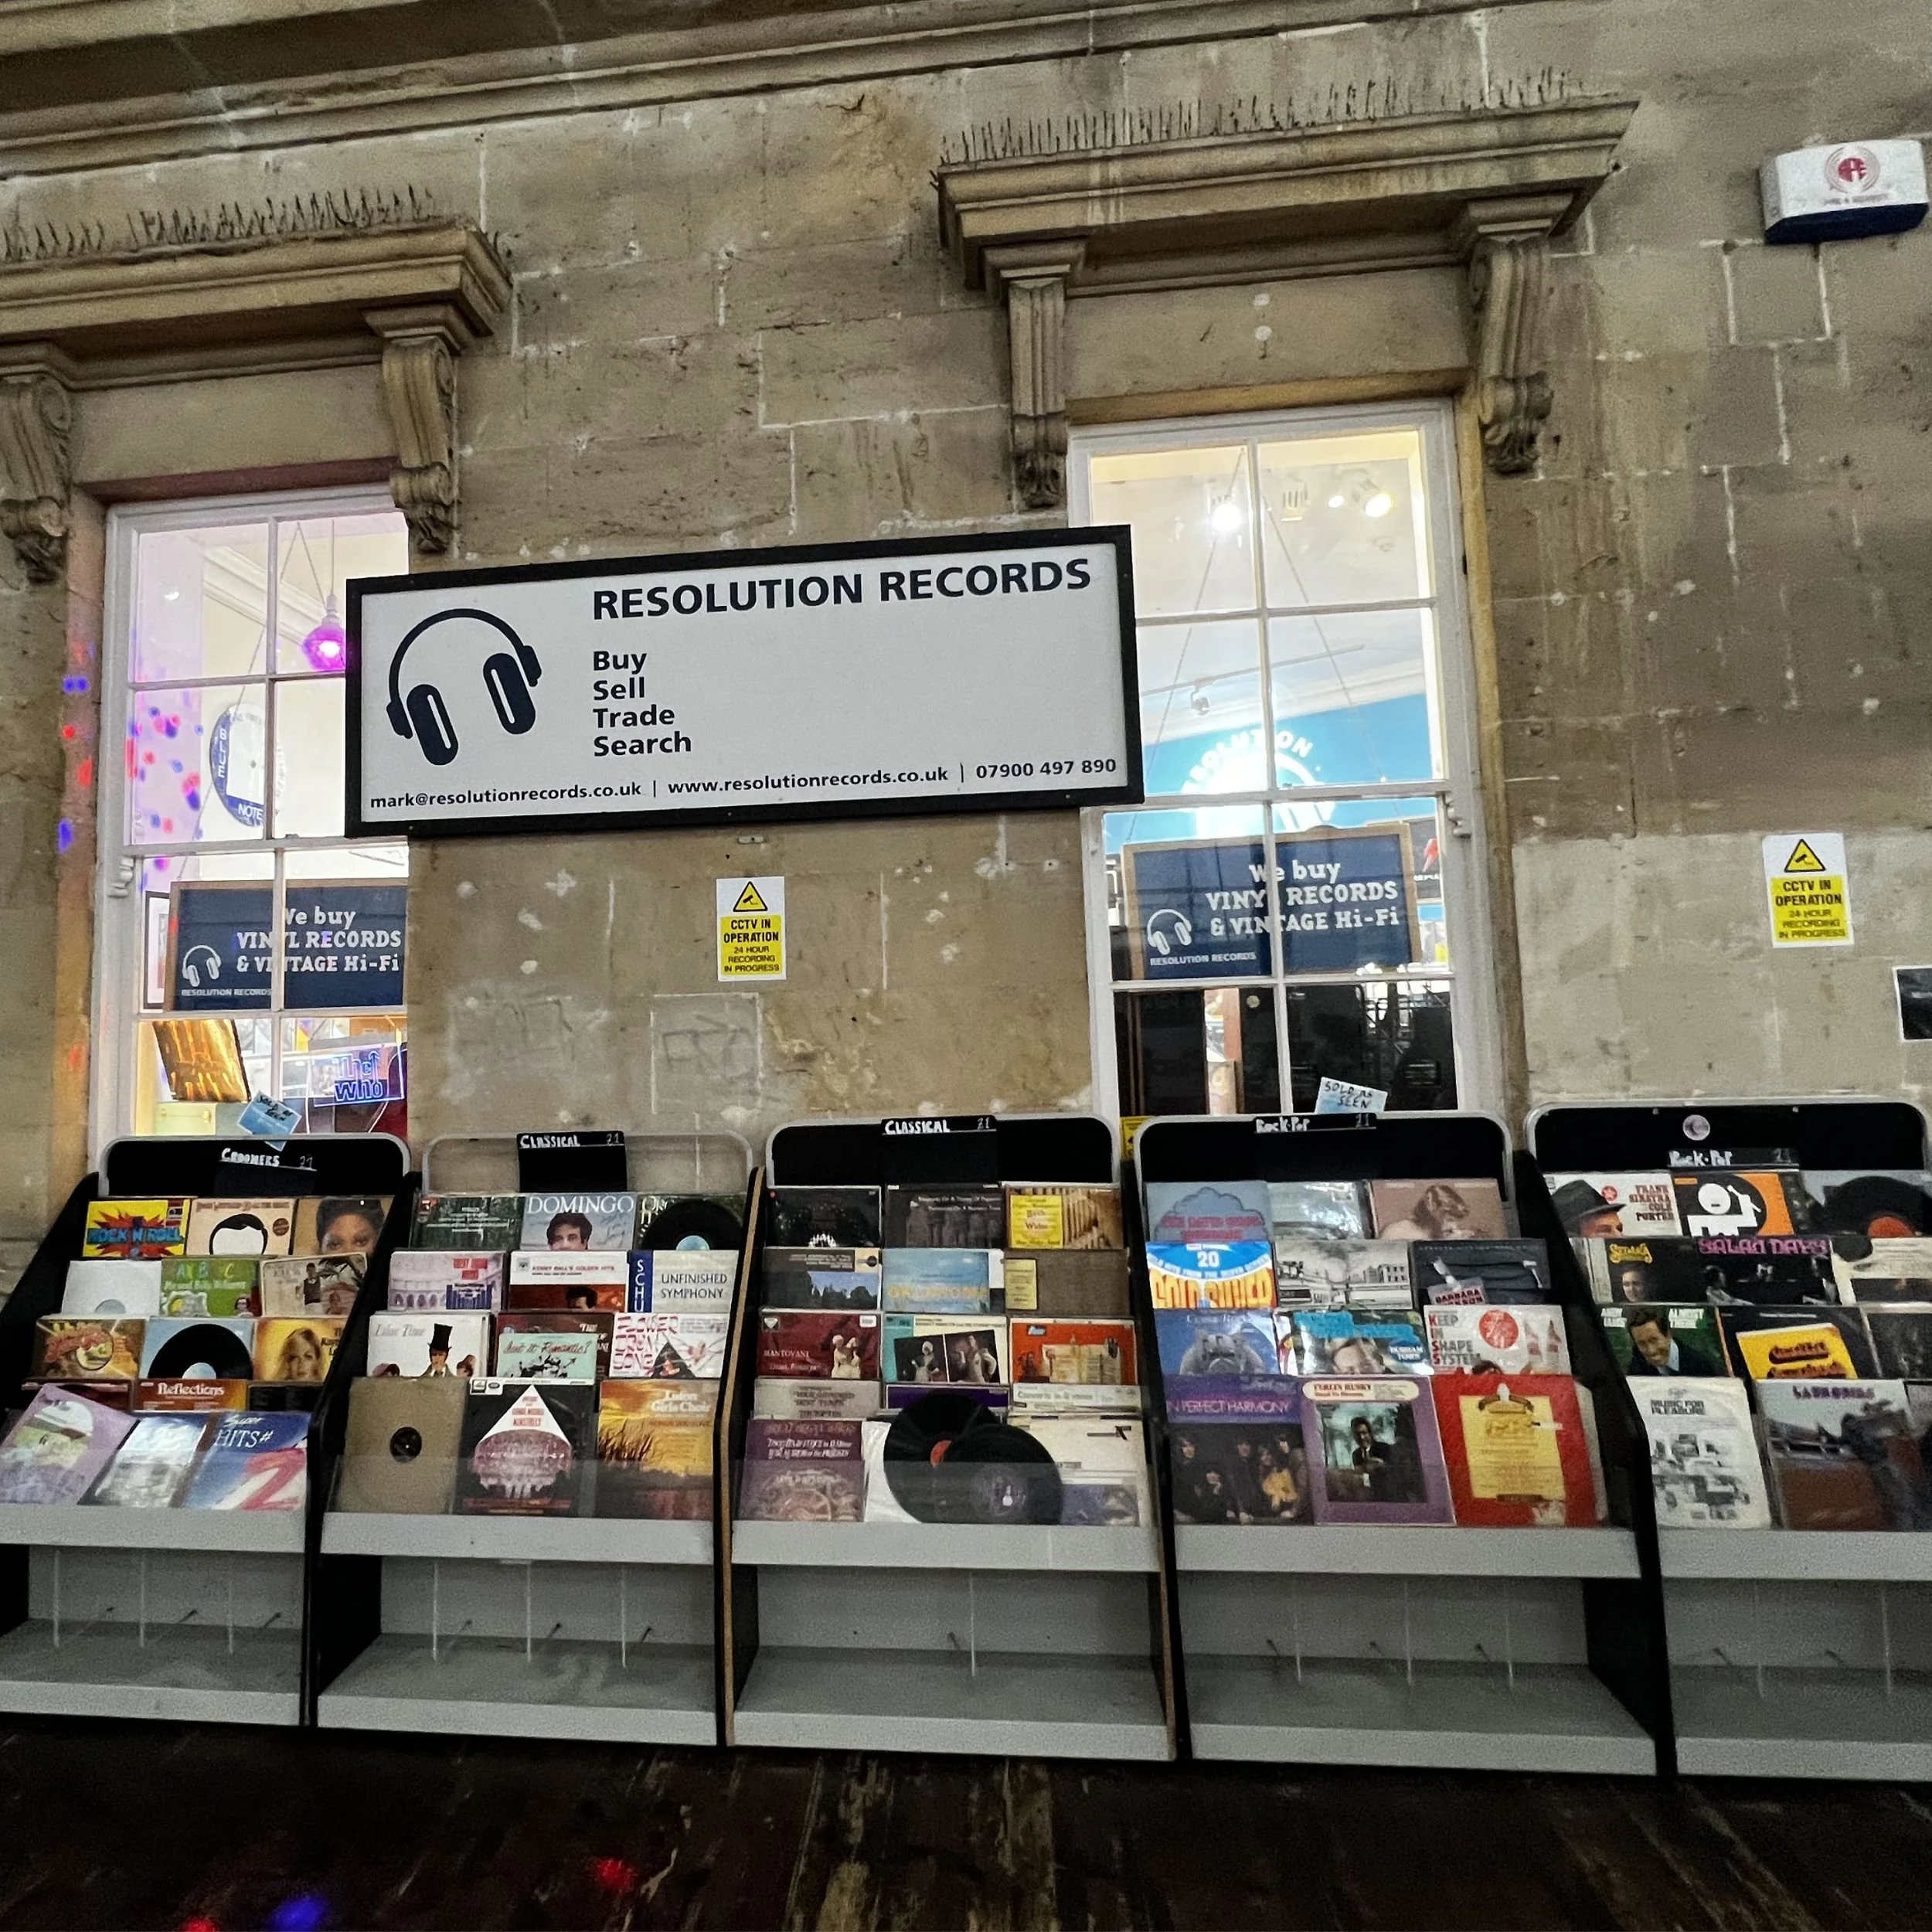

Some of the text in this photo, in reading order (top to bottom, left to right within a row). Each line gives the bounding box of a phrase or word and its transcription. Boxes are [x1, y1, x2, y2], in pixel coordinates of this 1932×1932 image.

[593, 558, 1090, 620] RESOLUTION RECORDS
[594, 651, 647, 675] Buy
[594, 677, 645, 701] Sell
[594, 704, 675, 729] Trade
[594, 731, 692, 757] Search
[370, 758, 1116, 808] mark@resolutionrecords.co.uk www.resolutionrecords.co.uk 07900 497 890
[238, 803, 264, 820] NOTE
[1292, 860, 1341, 883] buy
[1783, 879, 1832, 892] CCTV IN
[1205, 881, 1399, 910] VINY RECORDS
[1775, 893, 1842, 906] OPERATION
[315, 906, 356, 930] buy
[1804, 909, 1832, 917] HOUR
[731, 918, 771, 930] CCTV IN
[1209, 917, 1226, 936] &
[1335, 906, 1400, 928] Hi-Fi
[1783, 919, 1840, 928] RECORDING
[305, 930, 401, 948] RECORDS
[723, 931, 779, 944] OPERATION
[1791, 929, 1845, 938] PROGRESS
[236, 955, 249, 972] &
[344, 954, 400, 971] Hi-Fi
[1150, 951, 1257, 966] RESOLUTION RECORDS
[735, 964, 780, 972] PROGRESS
[1325, 1081, 1355, 1095] SOLD
[1635, 1185, 1669, 1194] FRANK
[528, 1196, 634, 1213] DOMINGO
[1628, 1194, 1672, 1202] SINATRA
[1648, 1202, 1672, 1211] COLE
[1635, 1212, 1675, 1221] PORTER
[1197, 1251, 1219, 1267] 20
[177, 1261, 236, 1280] A B C
[662, 1274, 727, 1284] UNFINISHED
[661, 1288, 724, 1299] SYMPHONY
[1435, 1289, 1480, 1304] BARBARA
[1428, 1314, 1458, 1327] KEEP
[1431, 1327, 1444, 1339] IN
[1432, 1340, 1473, 1352] SHAPE
[1432, 1352, 1481, 1366] SYSTEM
[158, 1382, 224, 1396] Reflections
[1227, 1400, 1291, 1414] HARMONY
